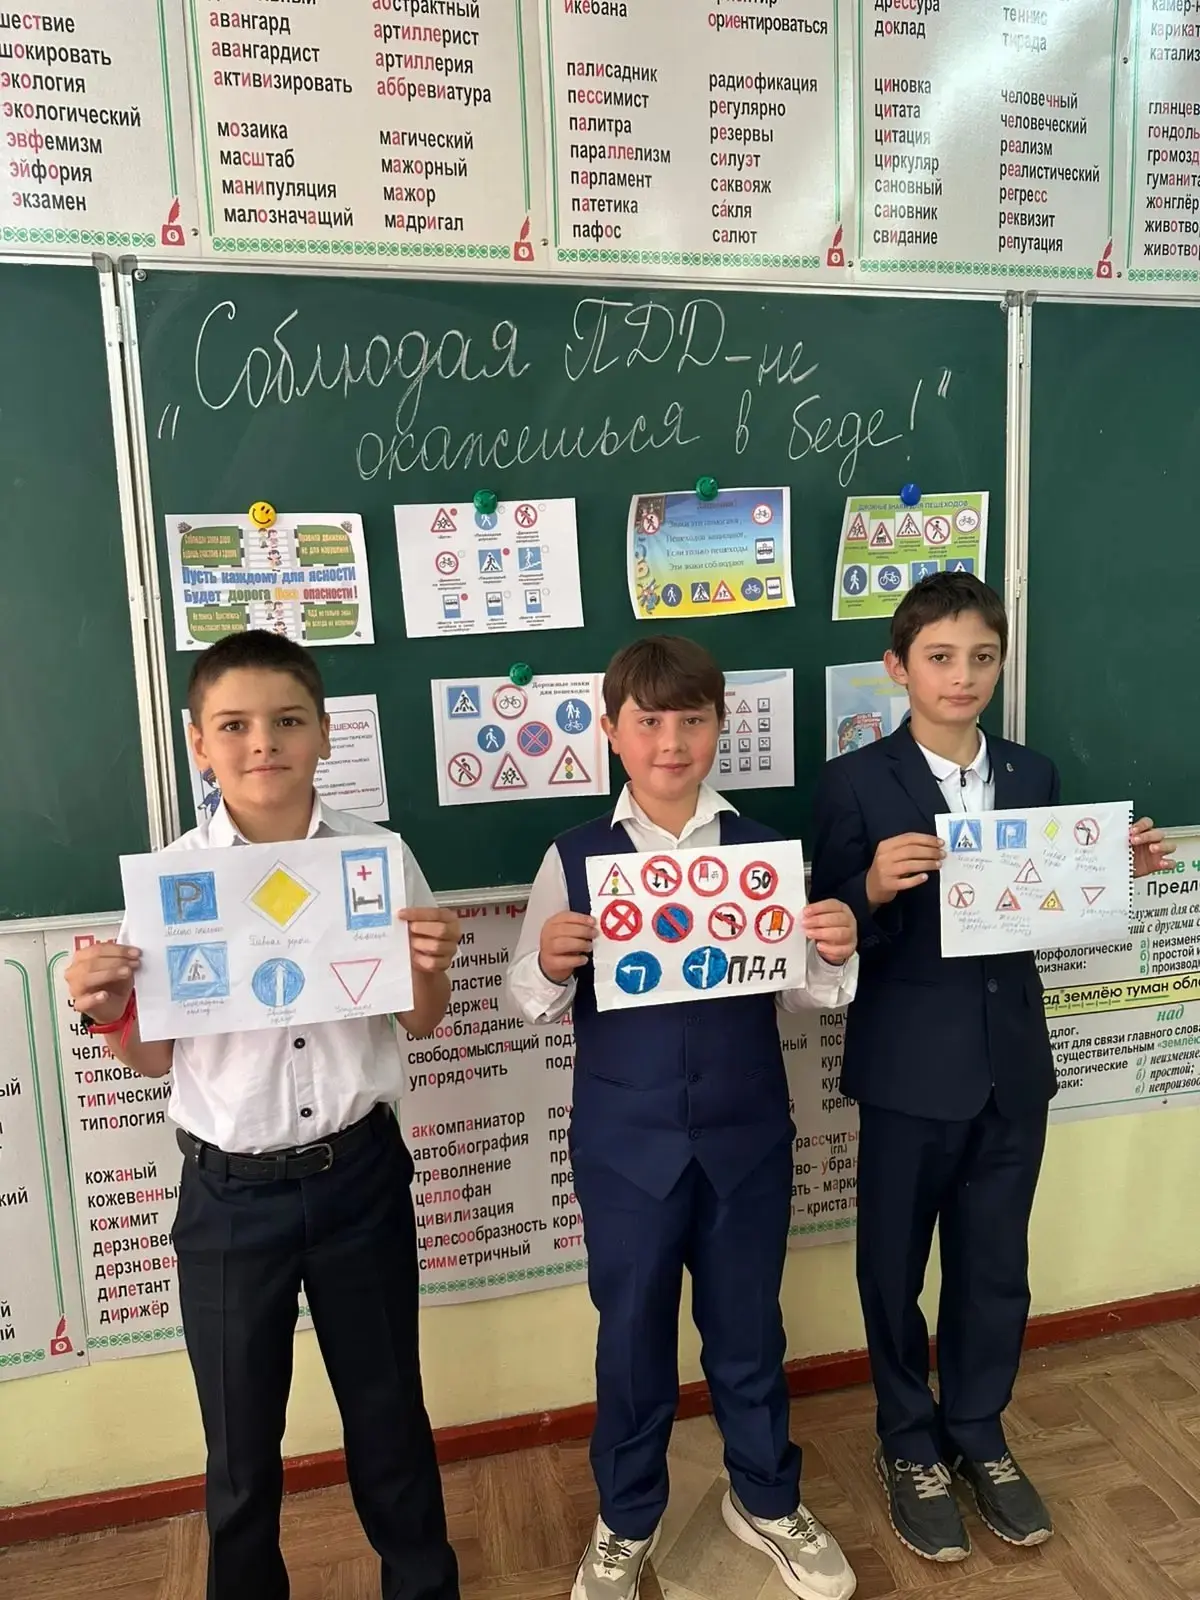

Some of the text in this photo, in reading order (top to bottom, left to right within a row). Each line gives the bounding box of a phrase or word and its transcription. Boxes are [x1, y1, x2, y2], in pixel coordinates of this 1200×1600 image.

[564, 0, 628, 17] икебана
[210, 11, 291, 35] авангард
[374, 21, 480, 46] артиллерист
[708, 11, 829, 34] ориентироваться
[874, 19, 926, 39] доклад
[211, 40, 320, 64] авангардист
[376, 49, 474, 76] артиллерия
[1, 71, 86, 93] экология
[213, 68, 353, 95] активизировать
[567, 60, 658, 82] палисадник
[377, 77, 492, 107] аббревиатура
[709, 71, 818, 95] радиофикация
[874, 77, 932, 96] циновка
[568, 89, 650, 109] пессимист
[710, 98, 787, 120] регулярно
[1001, 87, 1078, 109] человечный
[4, 100, 141, 127] экологический
[874, 102, 920, 120] цитата
[217, 119, 288, 140] мозаика
[569, 114, 632, 135] палитра
[1000, 111, 1088, 134] человеческий
[7, 129, 102, 154] эвфемизм
[380, 129, 474, 150] магический
[710, 124, 774, 145] резервы
[874, 128, 931, 148] цитация
[220, 147, 295, 169] масштаб
[571, 143, 672, 164] параллелизм
[1000, 137, 1053, 157] реализм
[382, 156, 468, 179] мажорный
[711, 151, 761, 169] силуэт
[874, 153, 940, 174] циркуляр
[10, 159, 92, 185] эйфория
[571, 170, 653, 189] парламент
[999, 161, 1101, 183] реалистический
[222, 177, 338, 200] манипуляция
[384, 184, 436, 206] мажор
[711, 176, 772, 194] саквояж
[874, 177, 943, 196] сановный
[999, 186, 1048, 206] регресс
[13, 190, 87, 211] экзамен
[572, 196, 639, 214] патетика
[874, 202, 938, 220] сановник
[1146, 194, 1199, 217] жонглёр
[224, 205, 354, 230] малозначащий
[385, 211, 464, 233] мадригал
[999, 209, 1056, 229] реквизит
[1145, 219, 1200, 237] животво
[573, 221, 622, 241] пафос
[713, 226, 758, 245] салют
[873, 226, 938, 246] свидание
[998, 234, 1064, 254] репутация
[356, 401, 701, 482] окажешься
[735, 389, 752, 455] в
[182, 566, 356, 586] Пусть каждому для ясности
[184, 589, 221, 605] Будет
[228, 587, 271, 603] дорога
[303, 585, 358, 601] опасности!
[751, 870, 771, 890] 50
[1152, 945, 1195, 962] простой
[727, 955, 787, 985] ПДД
[1037, 960, 1087, 973] ризнаки:
[1043, 994, 1060, 1006] ад
[1064, 987, 1123, 1004] землёю
[1127, 981, 1169, 997] туман
[1156, 1004, 1185, 1022] над
[1049, 1026, 1080, 1040] длог.
[1071, 1038, 1092, 1051] для
[1094, 1033, 1125, 1047] связи
[1127, 1027, 1173, 1042] главного
[407, 1033, 540, 1065] свободомыслящий
[1056, 1040, 1155, 1063] существительным
[410, 1063, 509, 1092] упорядочить
[1149, 1063, 1195, 1081] простой;
[78, 1081, 172, 1108] типический
[81, 1110, 166, 1132] типология
[412, 1110, 526, 1138] аккомпаниатор
[413, 1132, 529, 1162] автобиография
[86, 1161, 158, 1185] кожаный
[415, 1158, 512, 1186] треволнение
[88, 1183, 180, 1209] кожевенны
[416, 1183, 492, 1207] целлофан
[90, 1211, 159, 1232] кожимит
[417, 1201, 515, 1228] цивилизация
[418, 1218, 547, 1250] целесообразность
[419, 1239, 531, 1270] симметричный
[98, 1277, 172, 1303] дилетант
[100, 1299, 170, 1325] дирижёр
